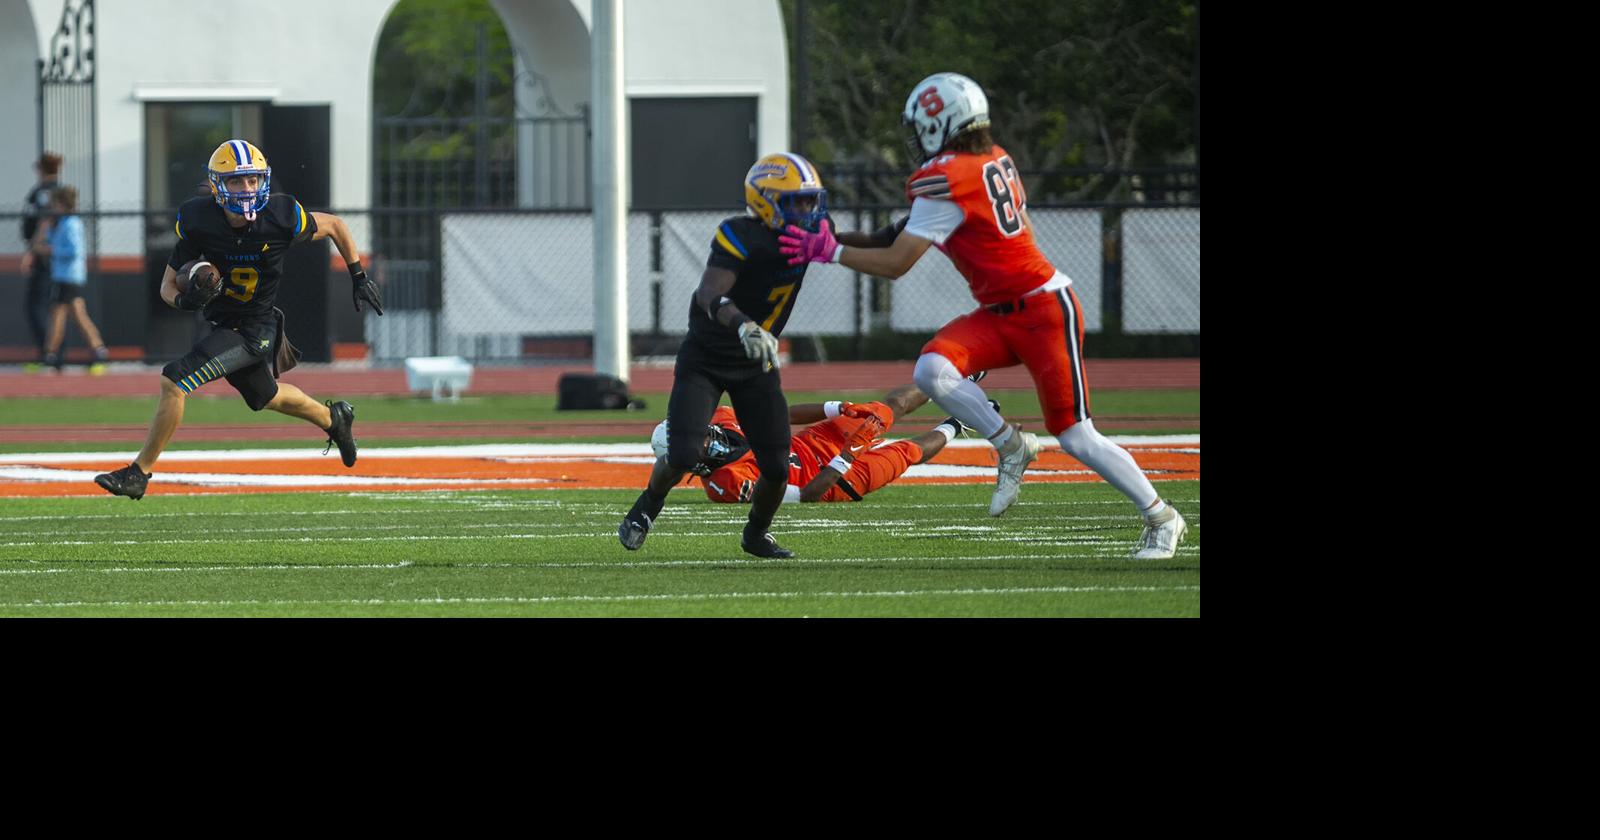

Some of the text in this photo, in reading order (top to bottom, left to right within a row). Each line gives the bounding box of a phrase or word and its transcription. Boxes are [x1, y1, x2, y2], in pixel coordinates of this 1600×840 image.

[918, 86, 945, 117] S
[224, 266, 260, 303] 9
[760, 282, 797, 333] 7
[709, 480, 725, 496] 1
